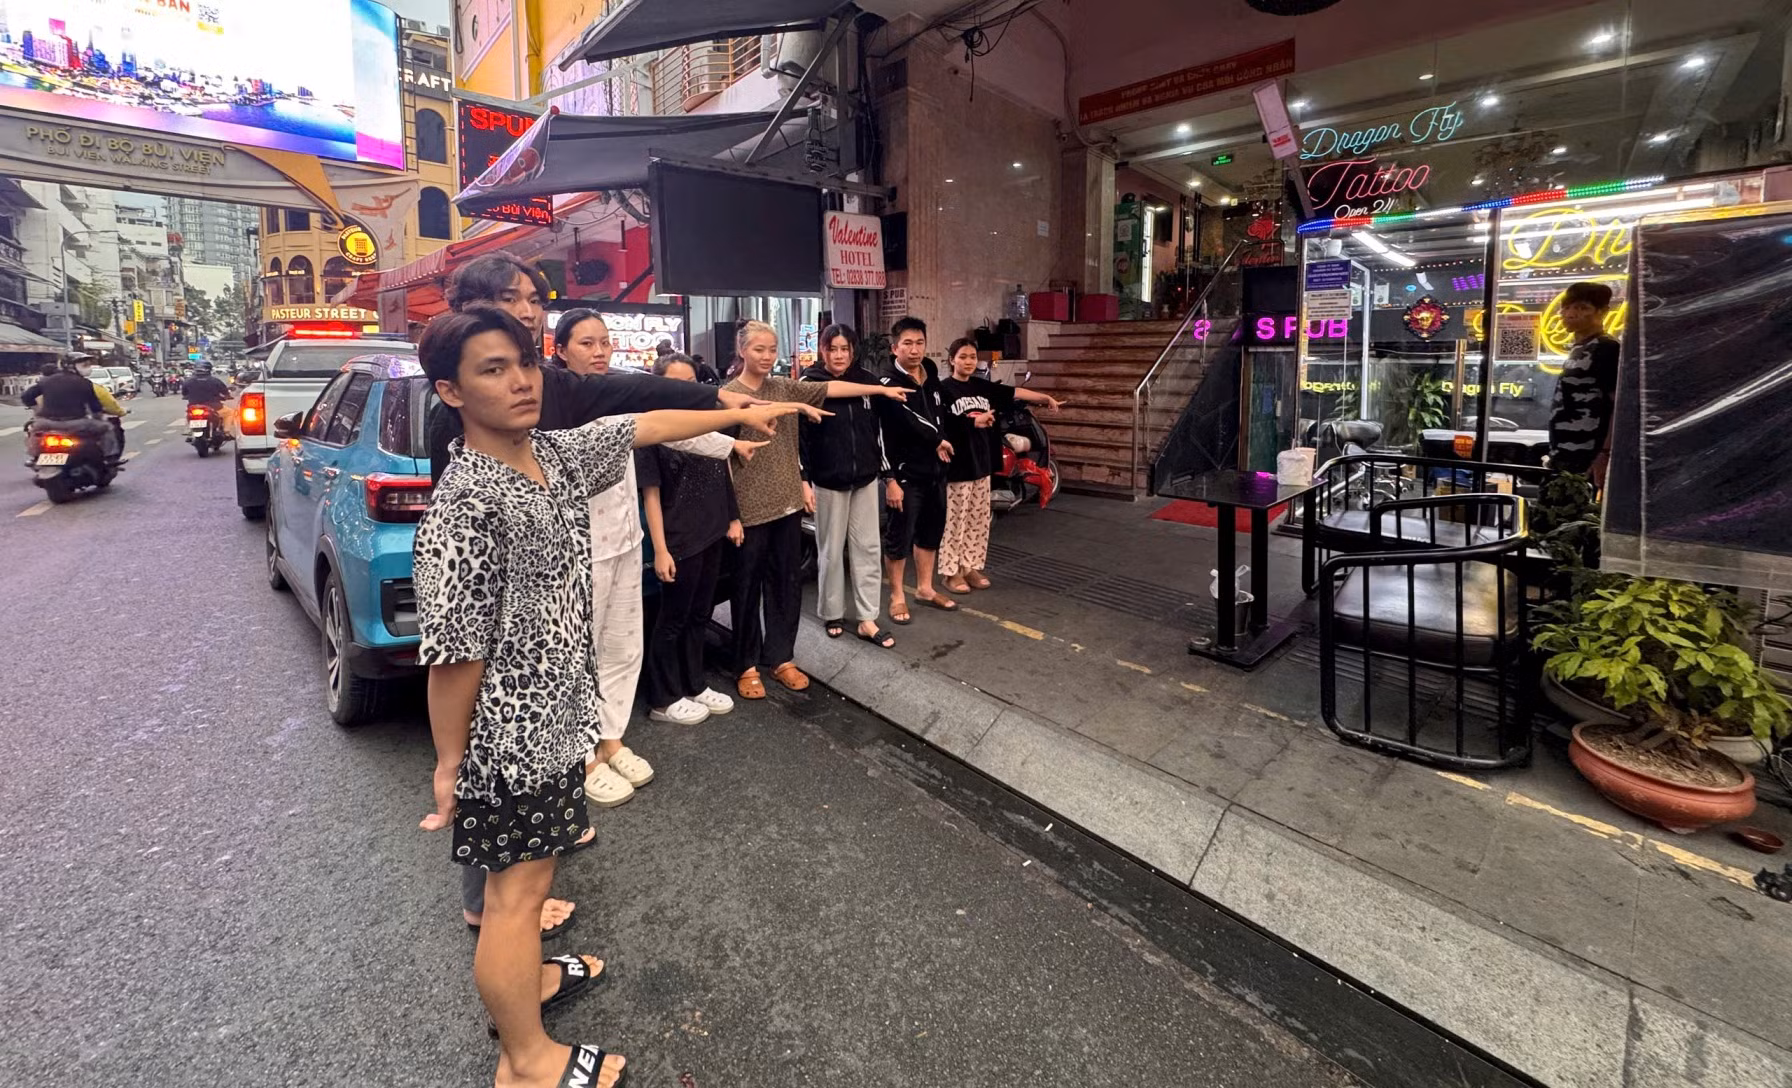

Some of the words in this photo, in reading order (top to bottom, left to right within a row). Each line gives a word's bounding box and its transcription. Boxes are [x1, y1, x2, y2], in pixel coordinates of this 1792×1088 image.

[398, 67, 452, 92] RAFT
[1300, 123, 1402, 159] Dragon
[1410, 101, 1463, 141] Fly
[26, 125, 72, 144] PHỐ
[79, 134, 100, 148] ĐI
[107, 136, 134, 155] BỘ
[143, 142, 173, 159] BÙI
[179, 149, 225, 168] VIỆN
[110, 154, 168, 170] WALKING
[172, 162, 212, 175] STREET
[1307, 157, 1430, 210] Tattoo
[1333, 204, 1369, 219] Open
[828, 215, 879, 247] Valentine
[840, 249, 875, 267] HOTEL
[831, 268, 846, 285] TEL:
[271, 308, 311, 320] PASTEUR
[315, 307, 367, 319] STREET
[644, 316, 682, 332] FLY
[1256, 317, 1275, 339] S
[1499, 382, 1524, 398] Fly
